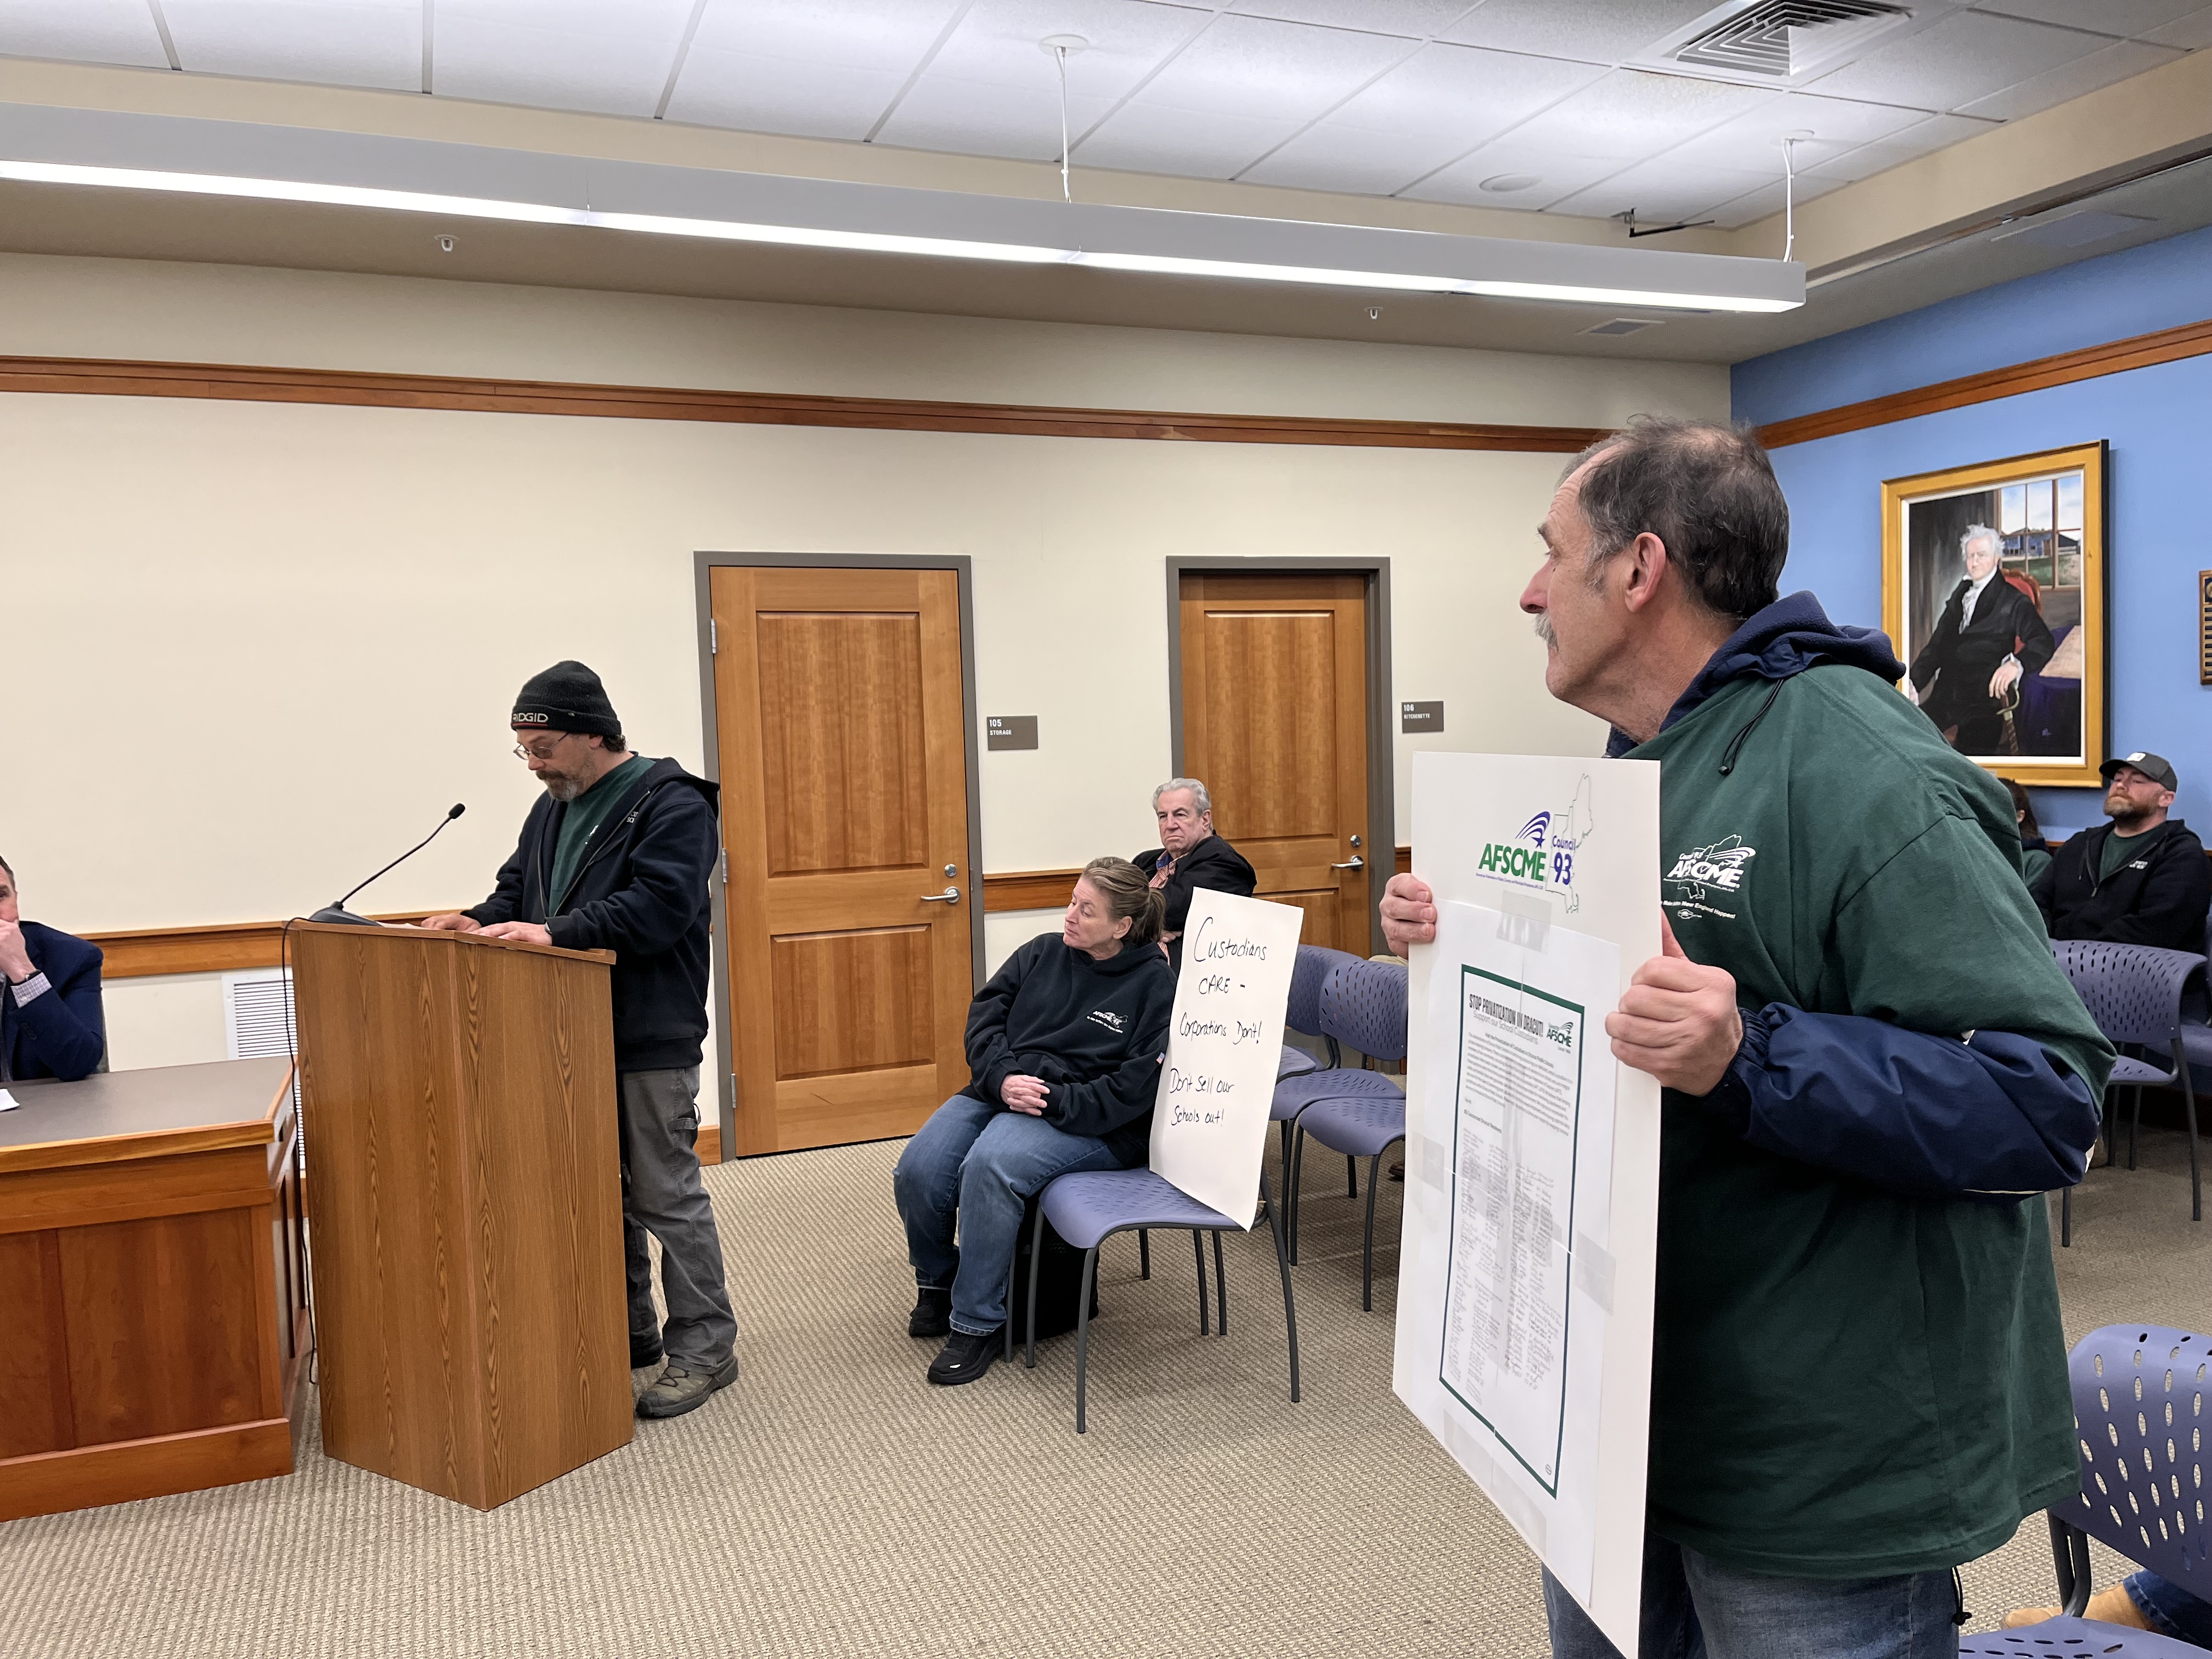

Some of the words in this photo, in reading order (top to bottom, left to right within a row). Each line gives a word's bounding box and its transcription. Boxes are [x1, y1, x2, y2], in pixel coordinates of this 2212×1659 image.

[989, 719, 1002, 727] 105
[1552, 835, 1576, 851] Council
[1478, 843, 1547, 882] AFSCME
[1554, 851, 1572, 885] 93
[1194, 916, 1267, 962] Custodians
[1198, 974, 1231, 995] CARE
[1469, 994, 1482, 1011] STOP
[1482, 998, 1516, 1025] PRIVATIZATION
[1473, 1009, 1491, 1022] Support
[1499, 1020, 1514, 1033] School
[1180, 1012, 1227, 1041] Corporations
[1232, 1020, 1262, 1045] Don't!
[1169, 1068, 1193, 1093] Don't
[1171, 1105, 1200, 1126] Schools
[1205, 1108, 1224, 1127] out!
